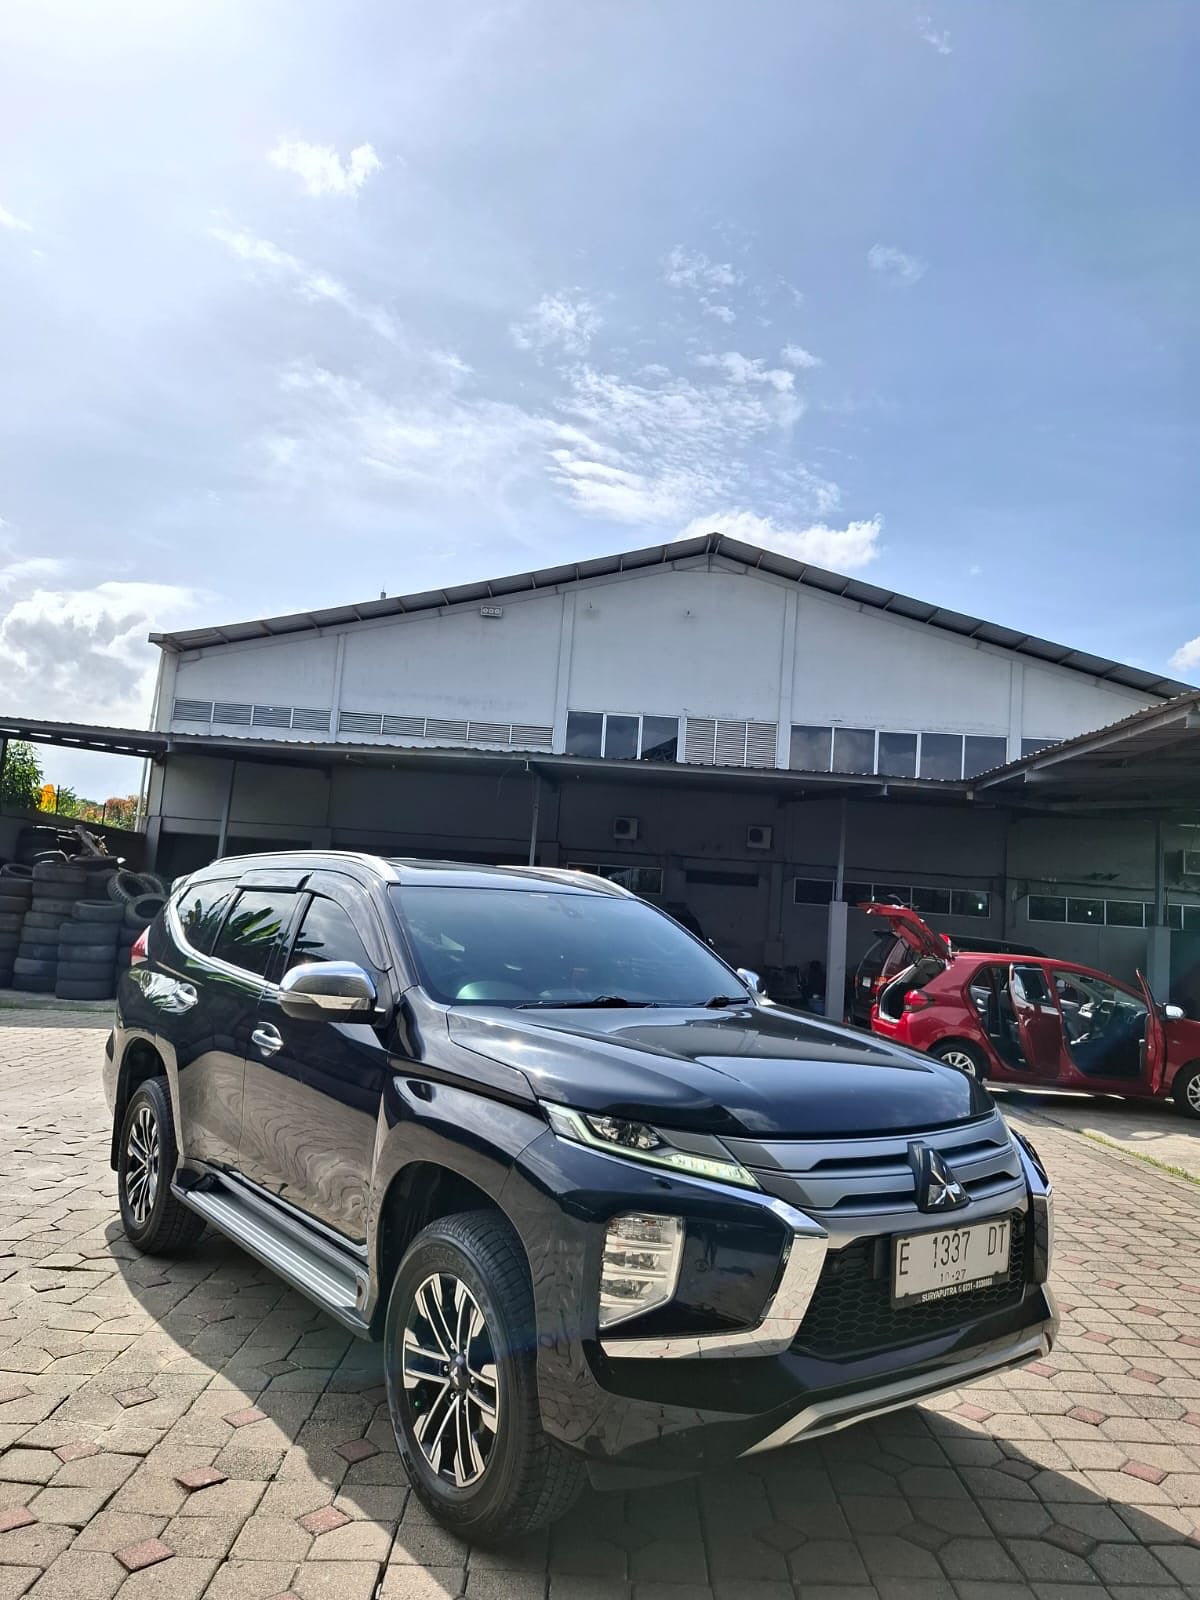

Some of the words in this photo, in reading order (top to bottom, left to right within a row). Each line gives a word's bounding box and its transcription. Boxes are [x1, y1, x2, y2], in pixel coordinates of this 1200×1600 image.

[899, 1242, 910, 1276] E
[932, 1231, 971, 1269] 1337
[988, 1224, 1007, 1256] DT
